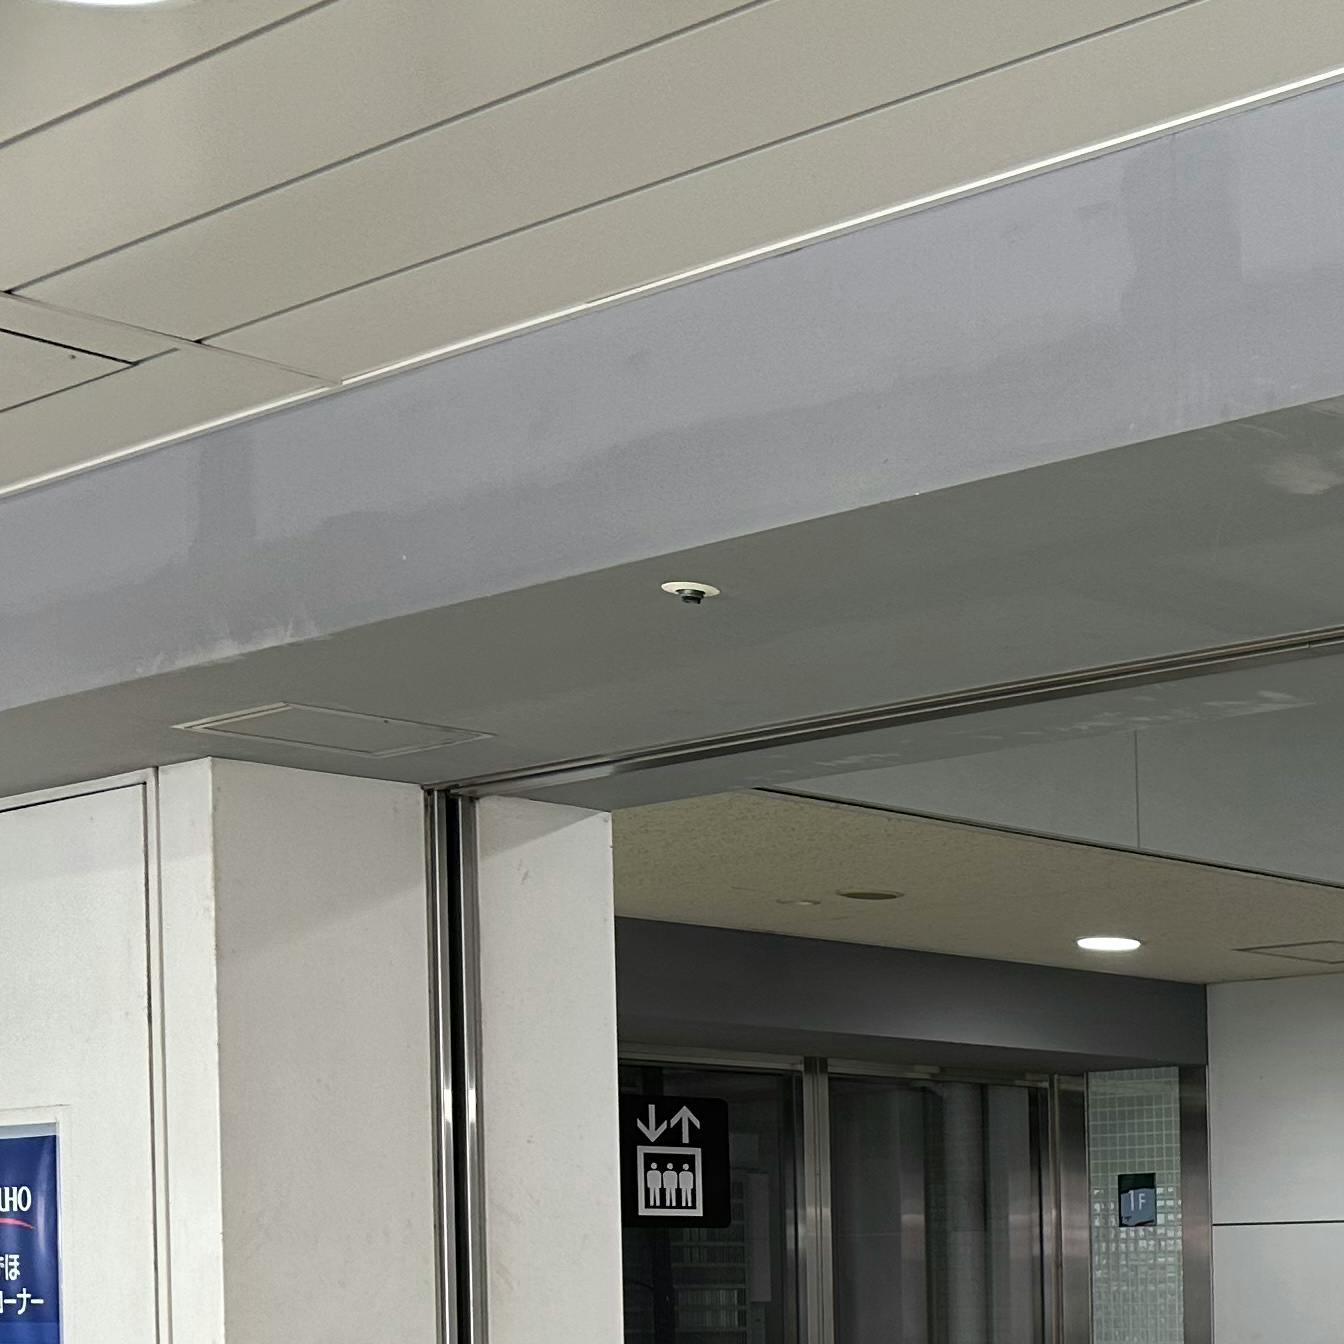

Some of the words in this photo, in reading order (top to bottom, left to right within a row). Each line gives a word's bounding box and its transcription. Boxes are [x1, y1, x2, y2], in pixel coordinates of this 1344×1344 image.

[1128, 1190, 1146, 1211] 1F
[0, 1253, 21, 1281] ほ
[0, 1287, 44, 1315] ーナー
